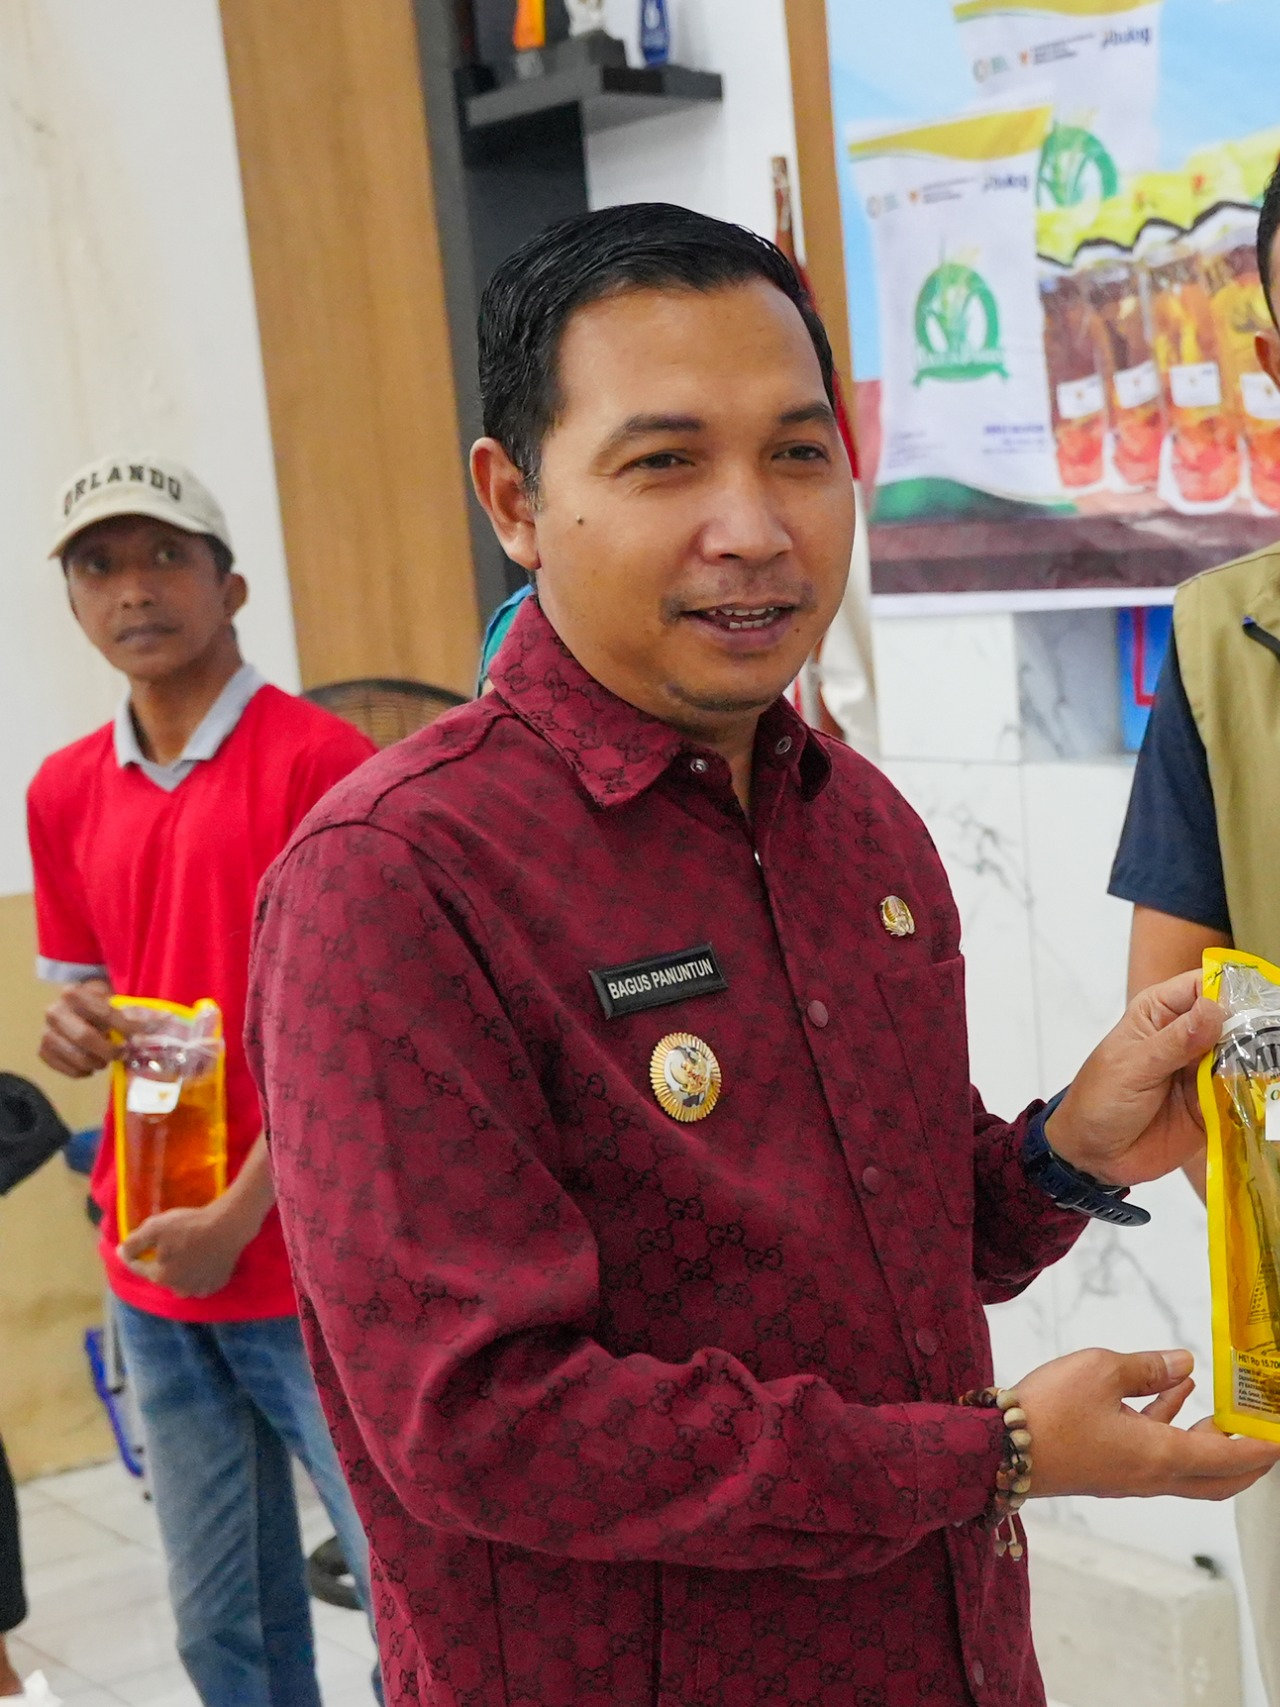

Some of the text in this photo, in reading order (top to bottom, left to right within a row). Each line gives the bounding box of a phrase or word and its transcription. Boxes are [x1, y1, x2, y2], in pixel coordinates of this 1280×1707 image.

[63, 464, 182, 517] ORLANDO
[607, 958, 714, 999] BAGUS PANUNTUN
